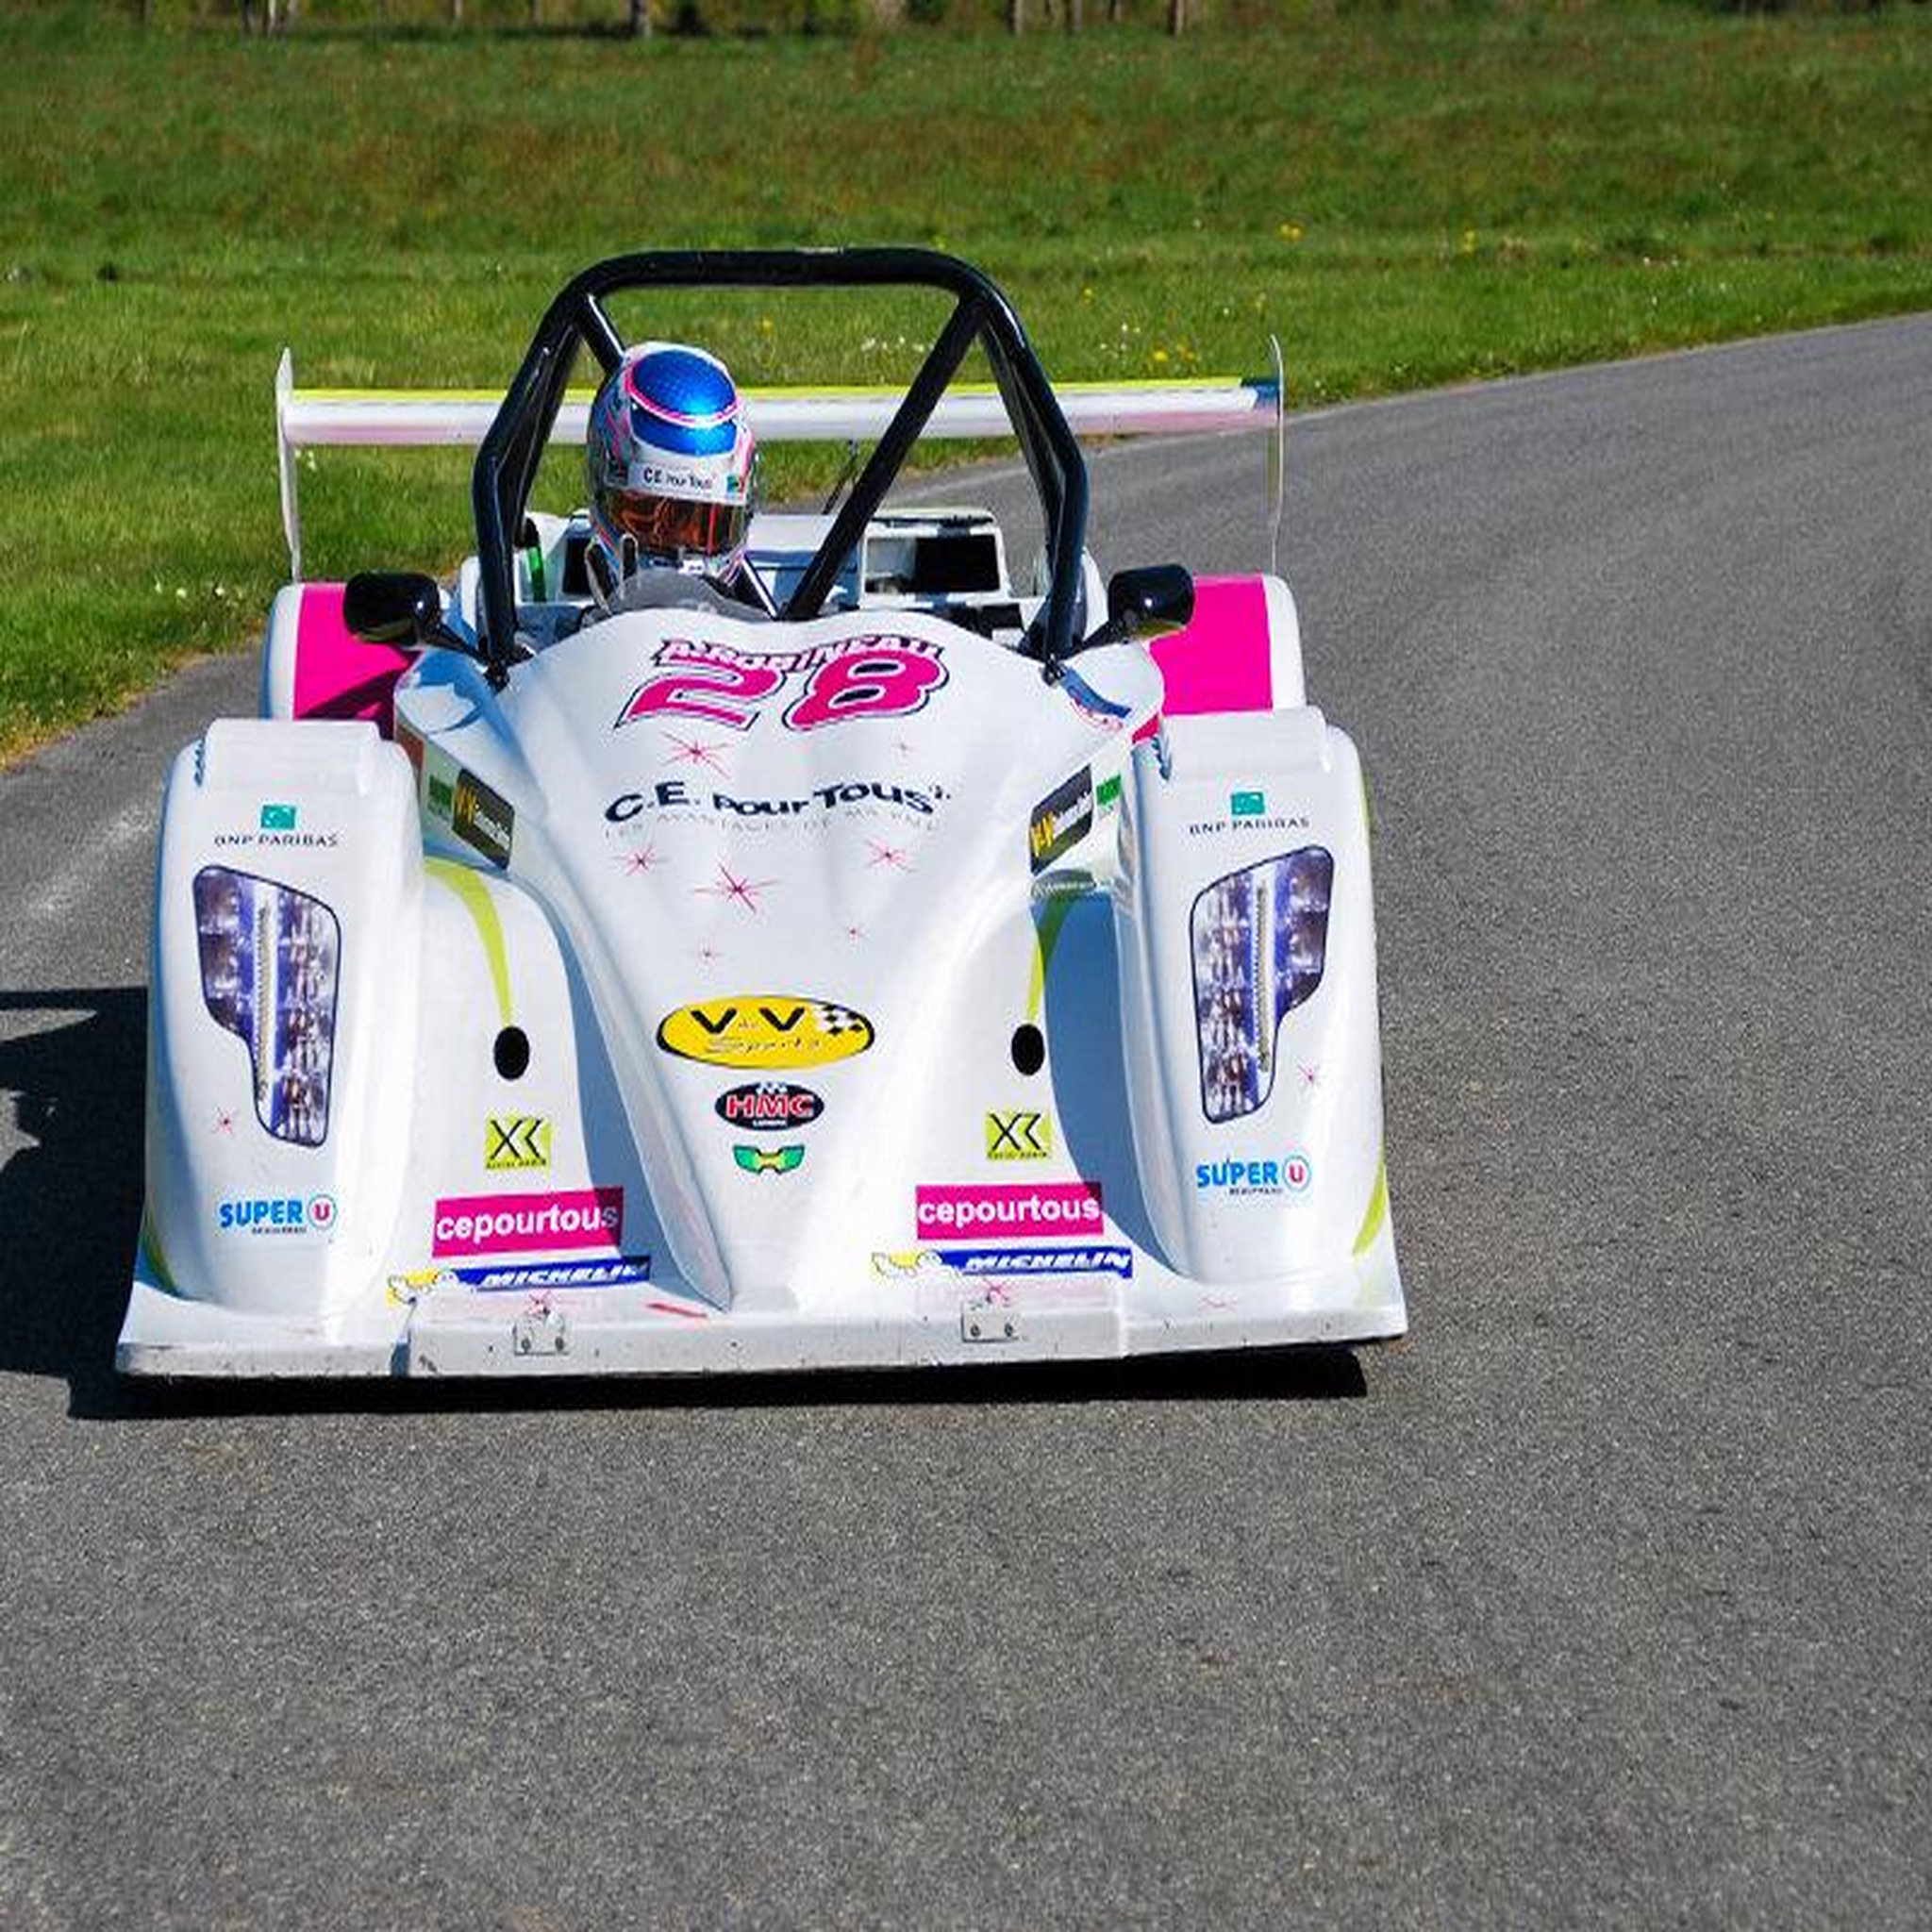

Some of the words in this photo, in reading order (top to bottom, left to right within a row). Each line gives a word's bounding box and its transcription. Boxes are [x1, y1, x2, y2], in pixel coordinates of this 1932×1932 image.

[614, 647, 950, 731] 28
[1190, 821, 1225, 835] BNP
[1232, 817, 1309, 830] PARIBAS
[213, 835, 254, 847] BNP
[258, 833, 338, 847] PARIBAS
[691, 1008, 737, 1033] V
[759, 1008, 806, 1030] V
[726, 1093, 814, 1118] HMC
[1197, 1161, 1279, 1188] SUPER
[220, 1200, 303, 1227] SUPER
[436, 1204, 619, 1243] cepourtous
[918, 1194, 1100, 1229] cepourtous
[966, 1252, 1131, 1270] MICHELIN
[479, 1262, 648, 1287] MICHELIN
